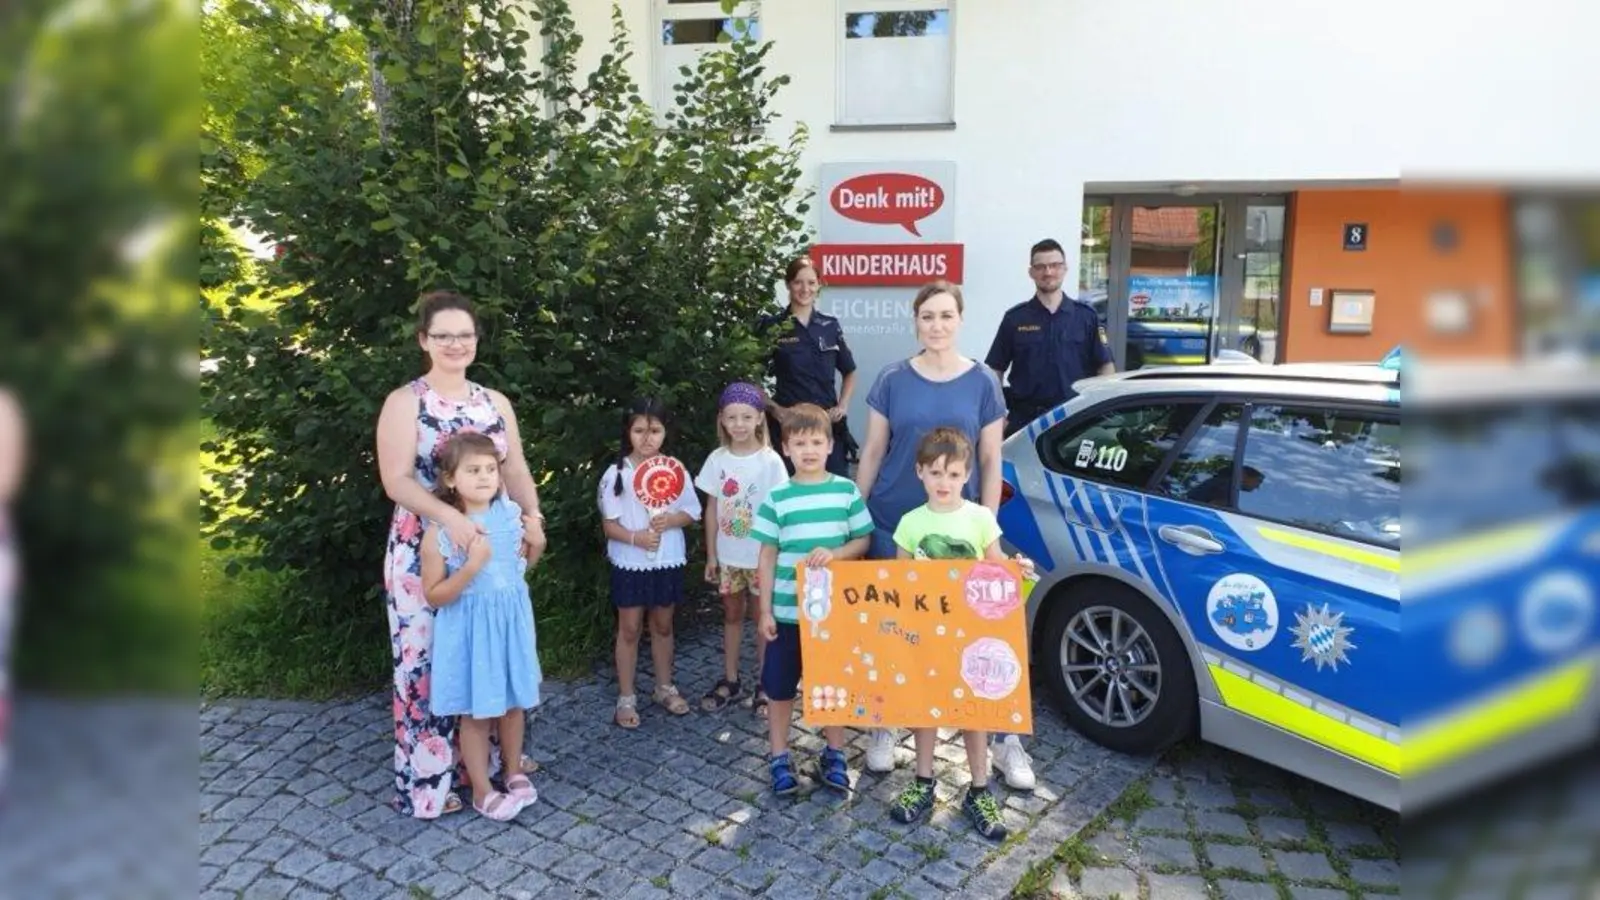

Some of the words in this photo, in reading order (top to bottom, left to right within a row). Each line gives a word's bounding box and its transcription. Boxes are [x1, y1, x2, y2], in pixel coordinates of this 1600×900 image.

[839, 187, 889, 208] Denk
[895, 186, 935, 208] mit!
[1351, 227, 1361, 243] 8
[822, 254, 947, 276] KINDERHAUS
[1094, 444, 1128, 472] 110
[966, 578, 1017, 602] STOP
